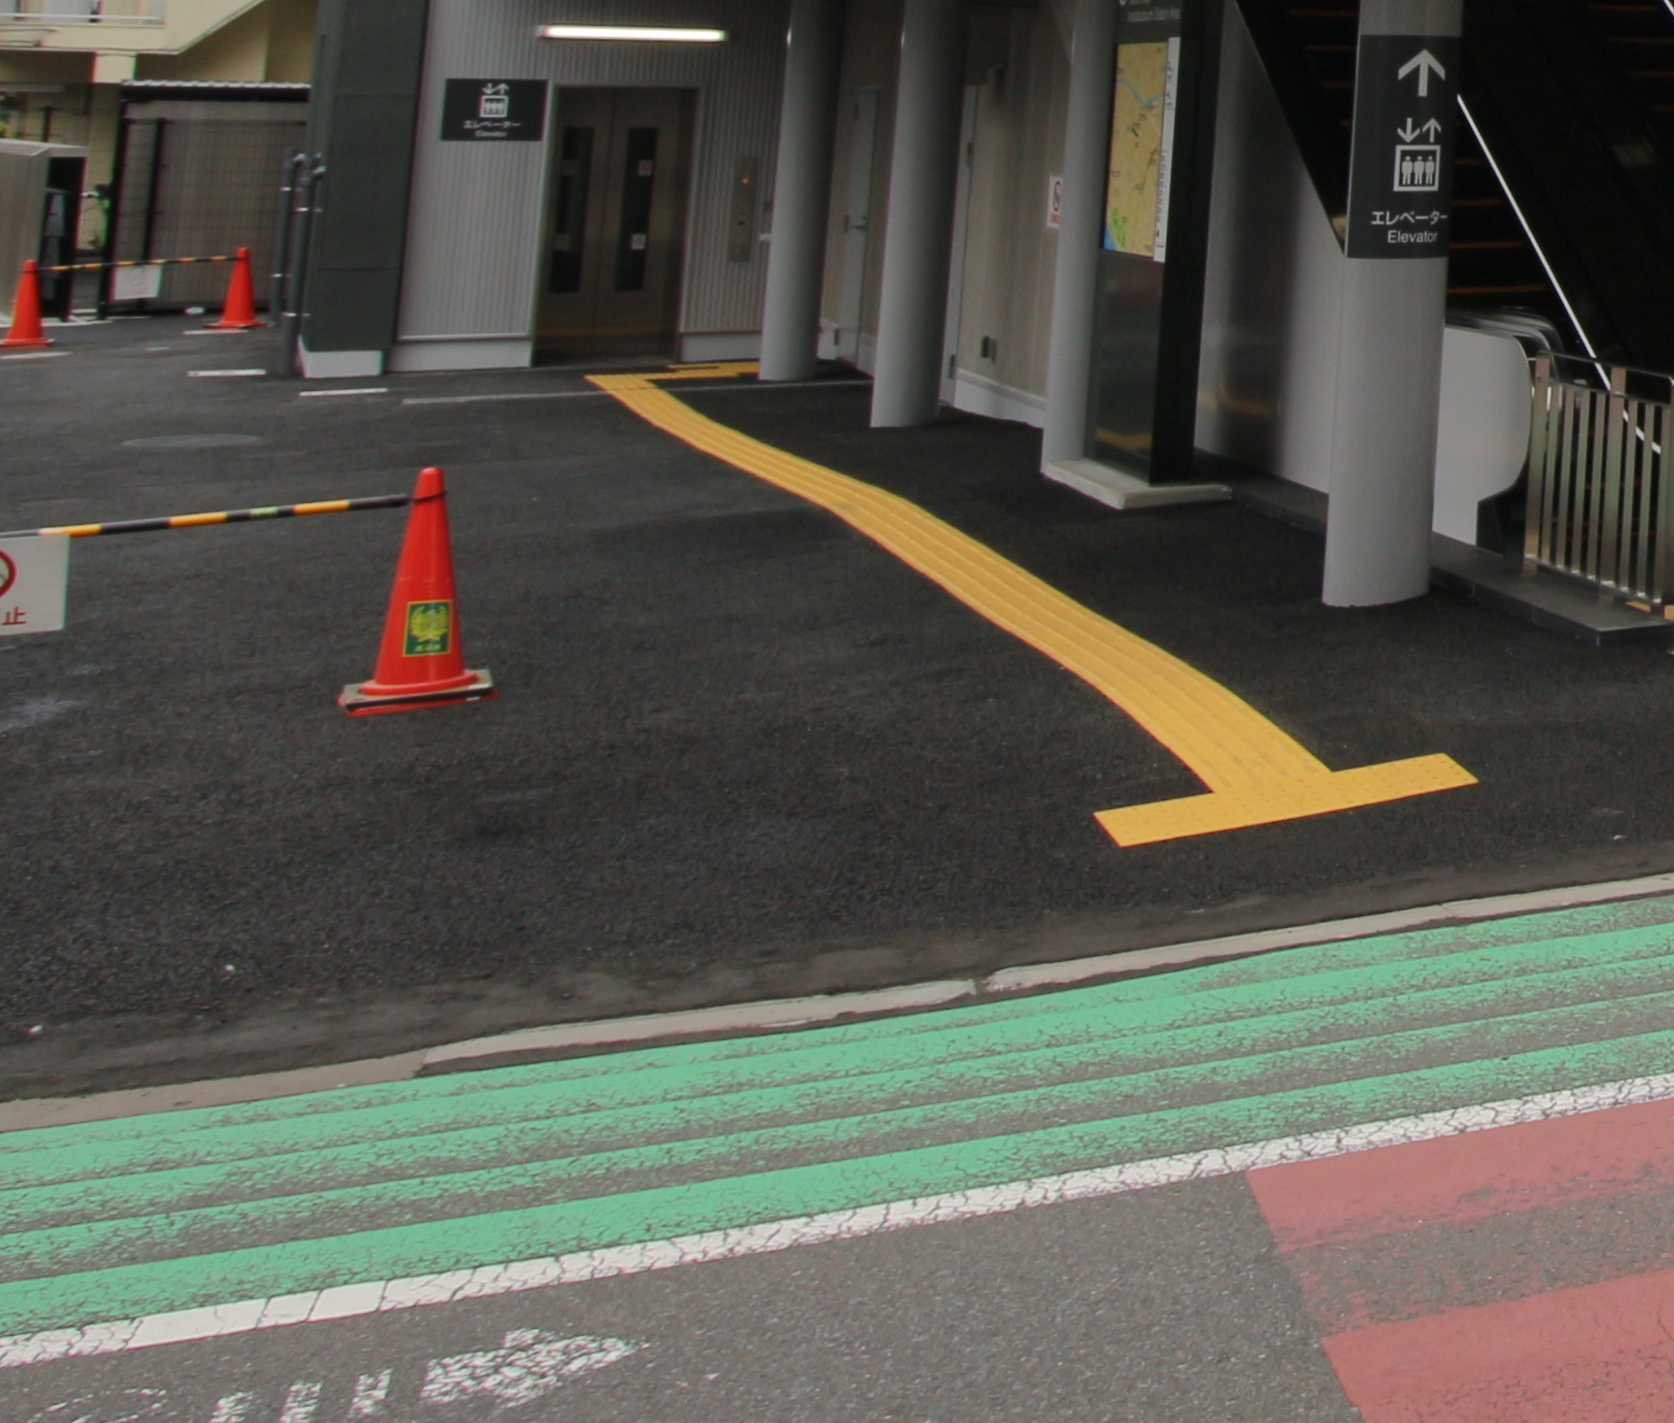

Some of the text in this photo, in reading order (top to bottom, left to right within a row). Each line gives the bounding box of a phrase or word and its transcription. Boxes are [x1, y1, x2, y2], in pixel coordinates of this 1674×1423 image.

[1371, 210, 1448, 226] エレベーター
[1387, 230, 1438, 244] Elevator
